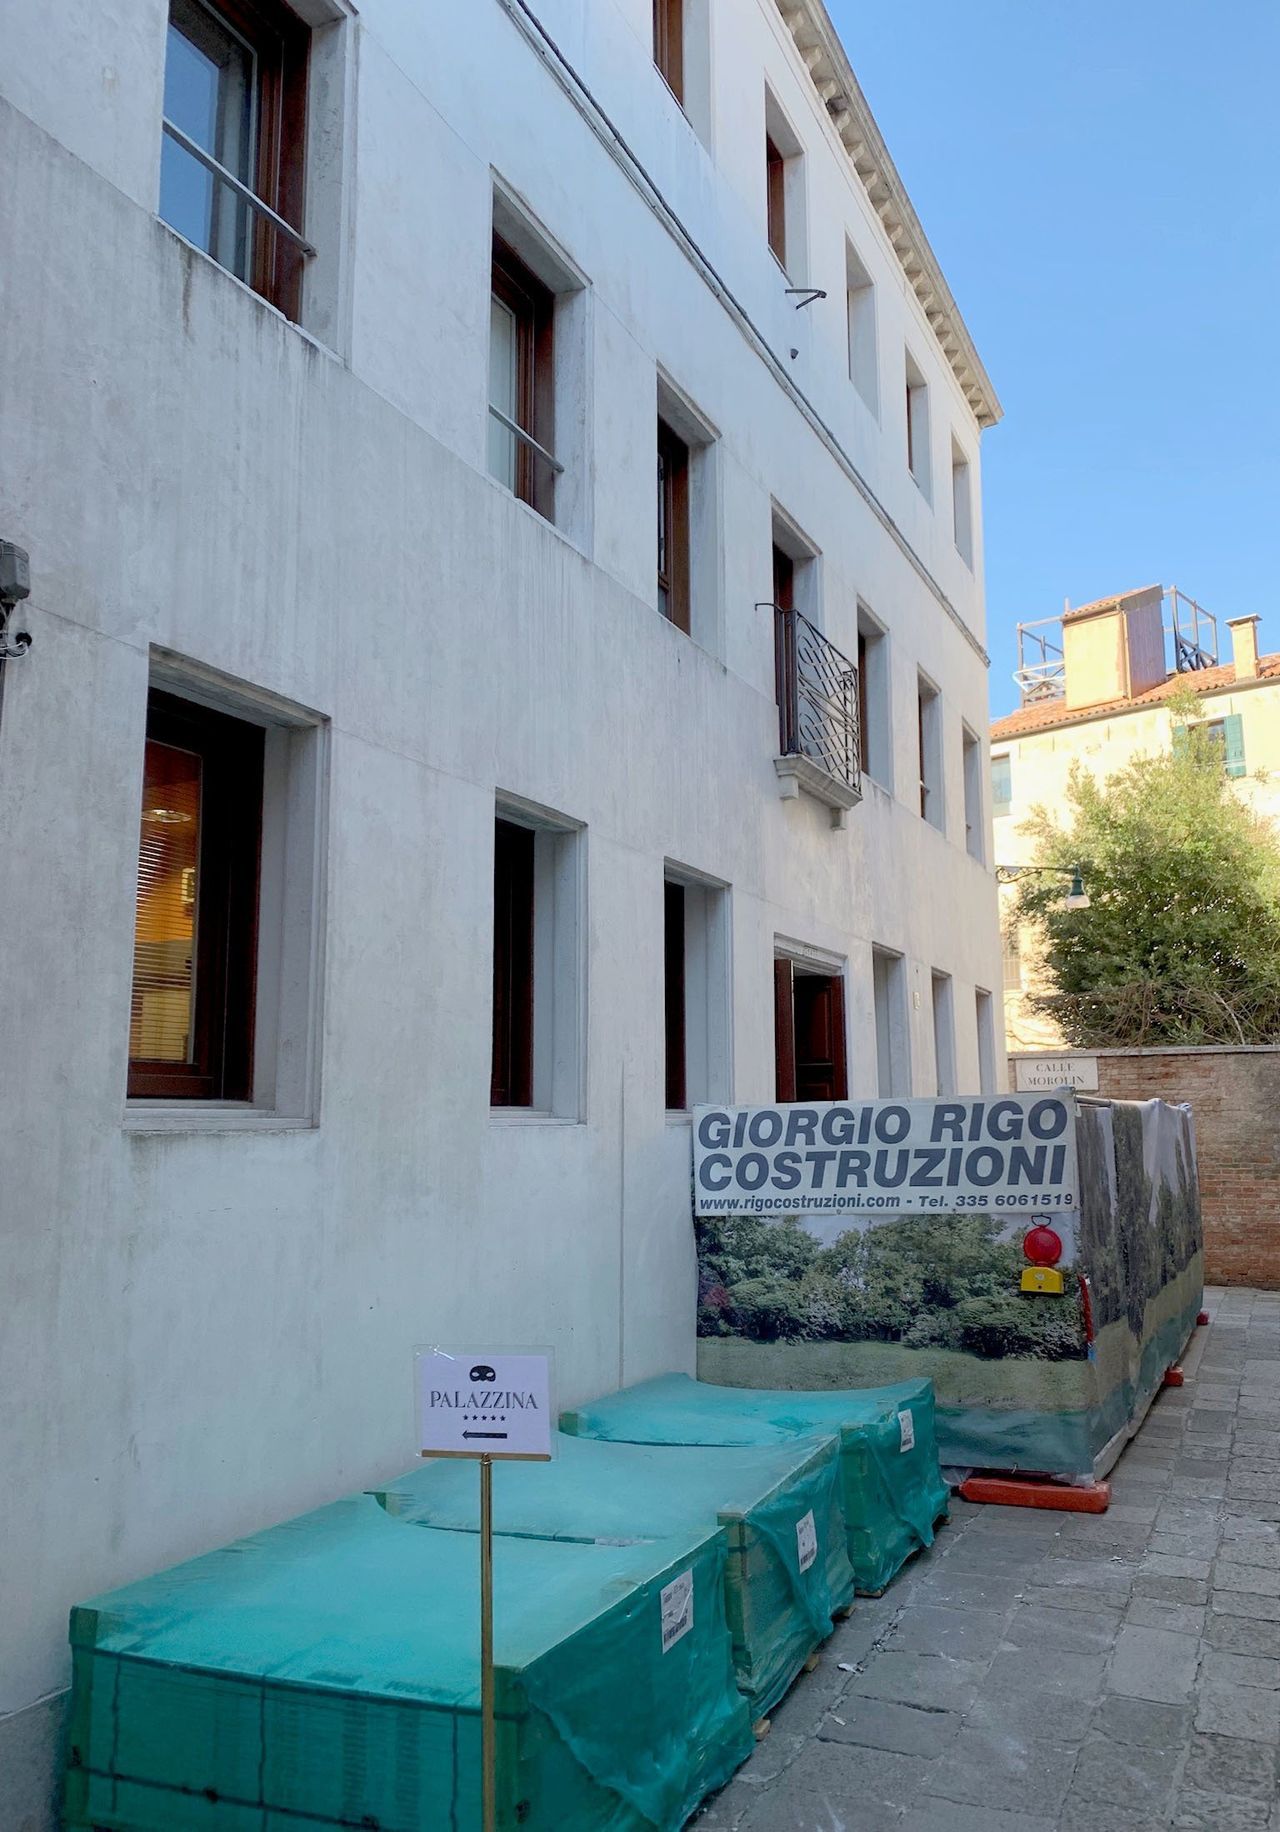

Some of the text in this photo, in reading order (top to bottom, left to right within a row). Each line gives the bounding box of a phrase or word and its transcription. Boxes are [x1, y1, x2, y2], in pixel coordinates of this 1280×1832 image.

[1036, 1063, 1075, 1072] CALLE
[699, 1098, 1068, 1149] GIORGIO RIGO
[699, 1144, 1067, 1192] COSTRUZIONI
[700, 1193, 900, 1212] www.rigocostruzioni.com
[919, 1195, 949, 1207] Tel.
[955, 1194, 988, 1207] 335
[995, 1193, 1073, 1206] 6061519
[429, 1390, 539, 1409] PALAZZINA
